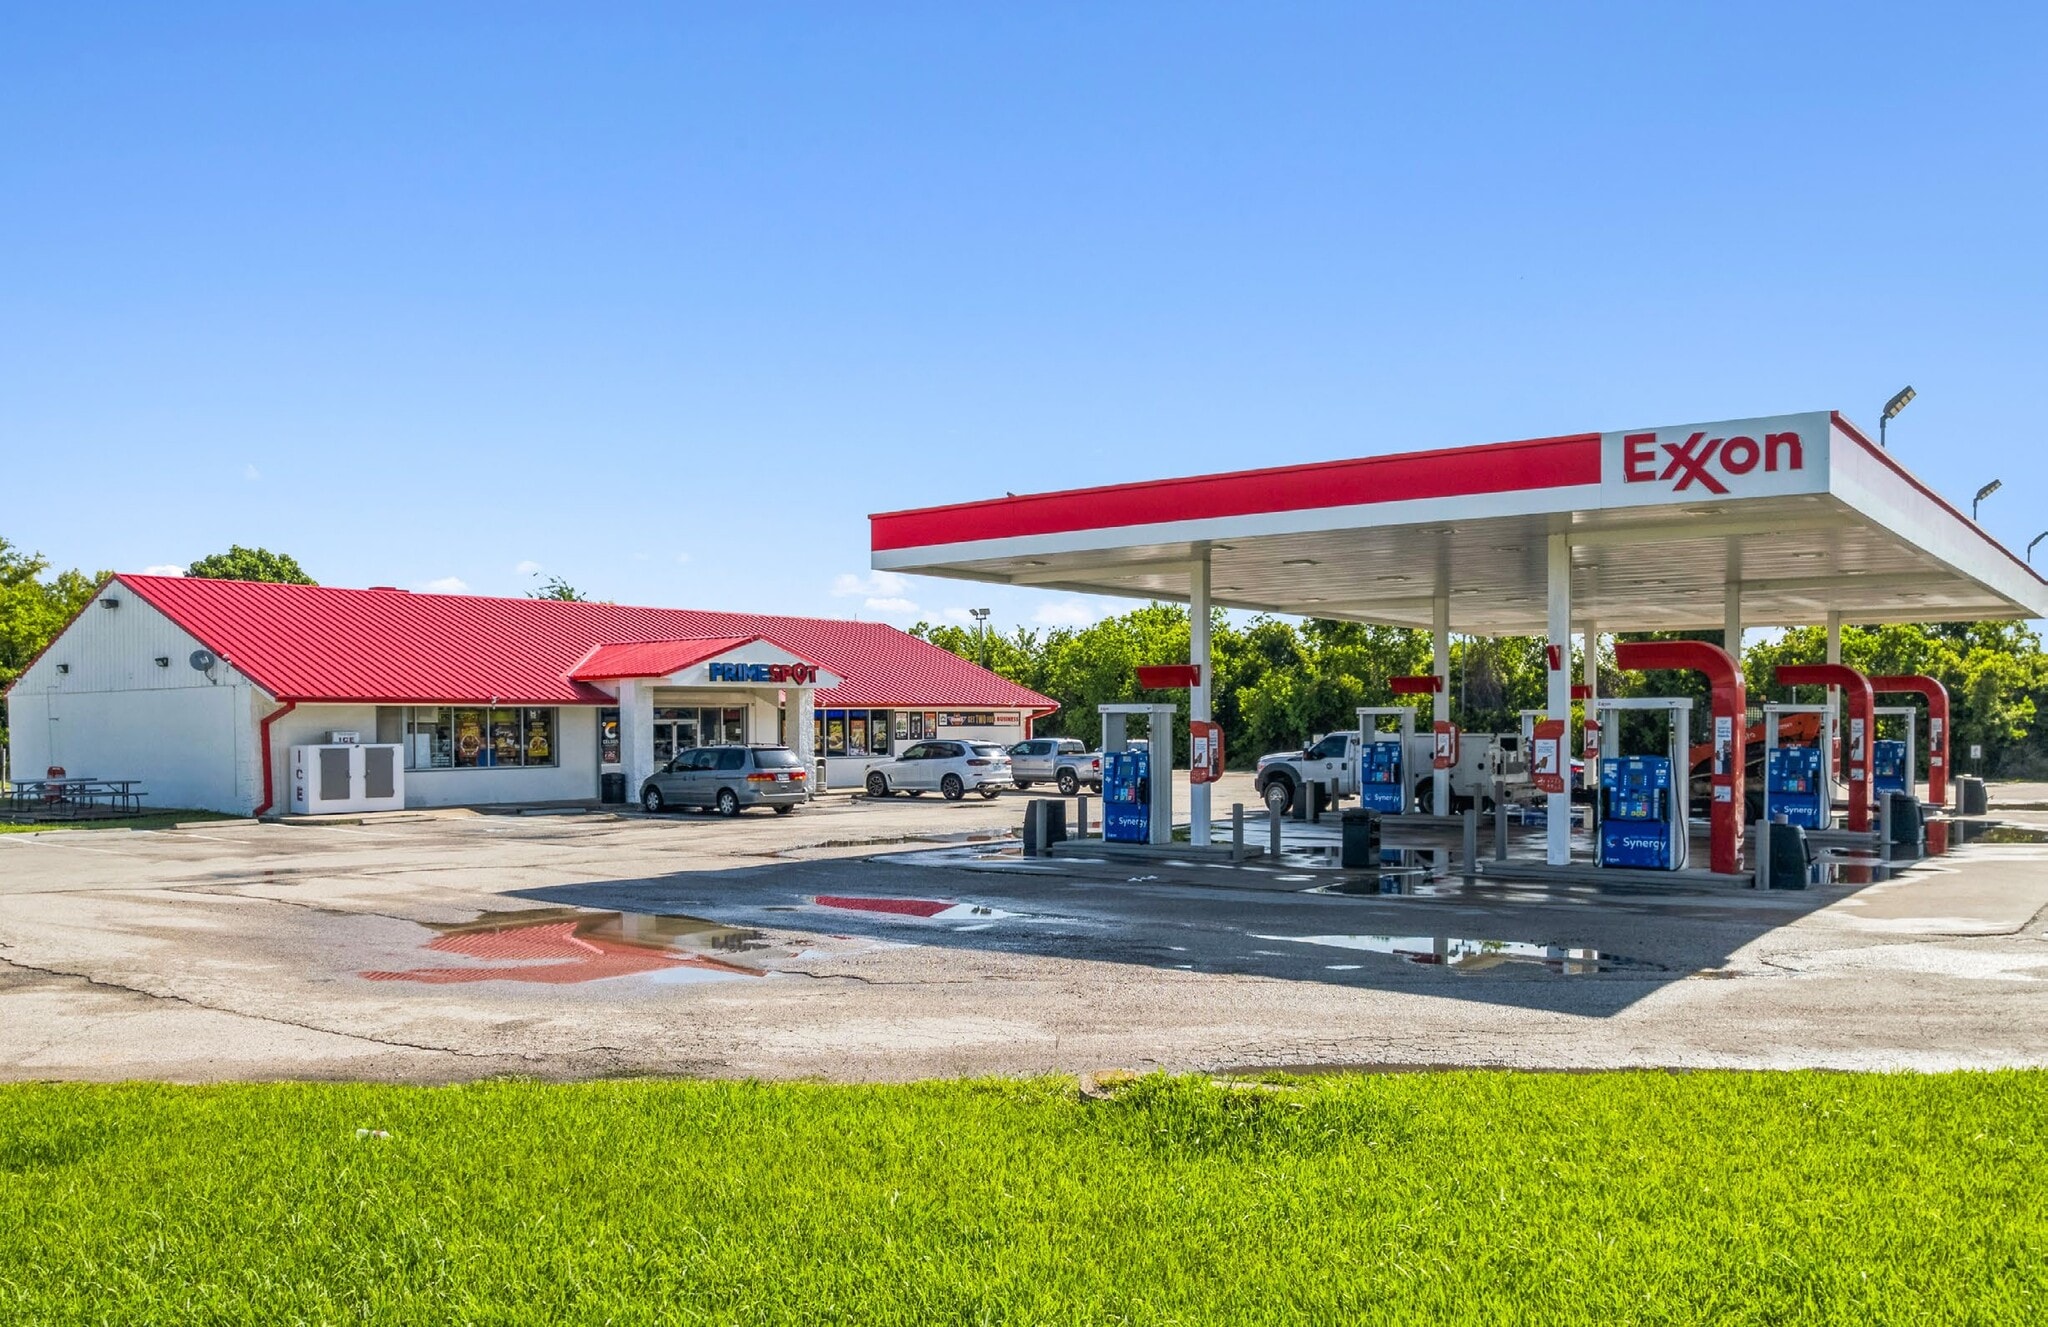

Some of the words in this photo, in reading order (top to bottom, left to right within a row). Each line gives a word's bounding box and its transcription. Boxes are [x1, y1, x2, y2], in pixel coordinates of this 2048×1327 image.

[1623, 431, 1803, 495] Exxon
[709, 662, 819, 685] PRIMESPOT
[338, 736, 355, 744] ICE
[294, 749, 304, 803] ICE
[1622, 836, 1667, 851] Synergy
